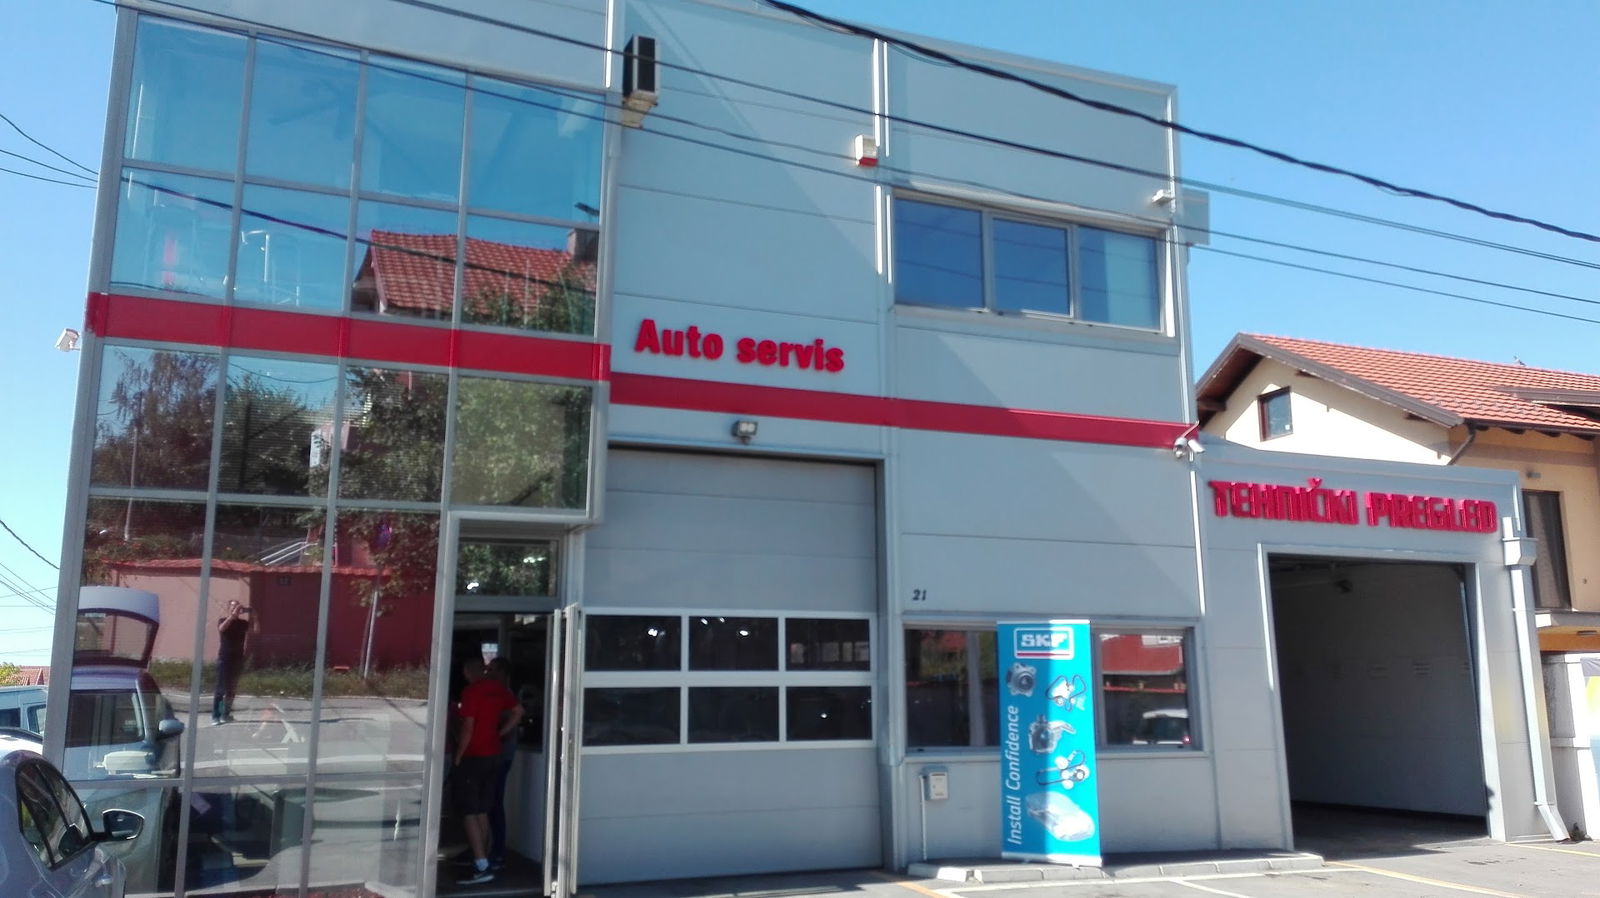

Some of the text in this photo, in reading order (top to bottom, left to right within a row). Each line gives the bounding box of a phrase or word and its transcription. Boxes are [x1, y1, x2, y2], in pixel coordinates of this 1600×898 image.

[635, 319, 844, 372] Auto servis
[1209, 478, 1498, 533] TEHNIČKI PREGLED
[912, 589, 927, 601] 21
[1021, 633, 1068, 648] SKF
[1005, 705, 1022, 845] Install Confidence
